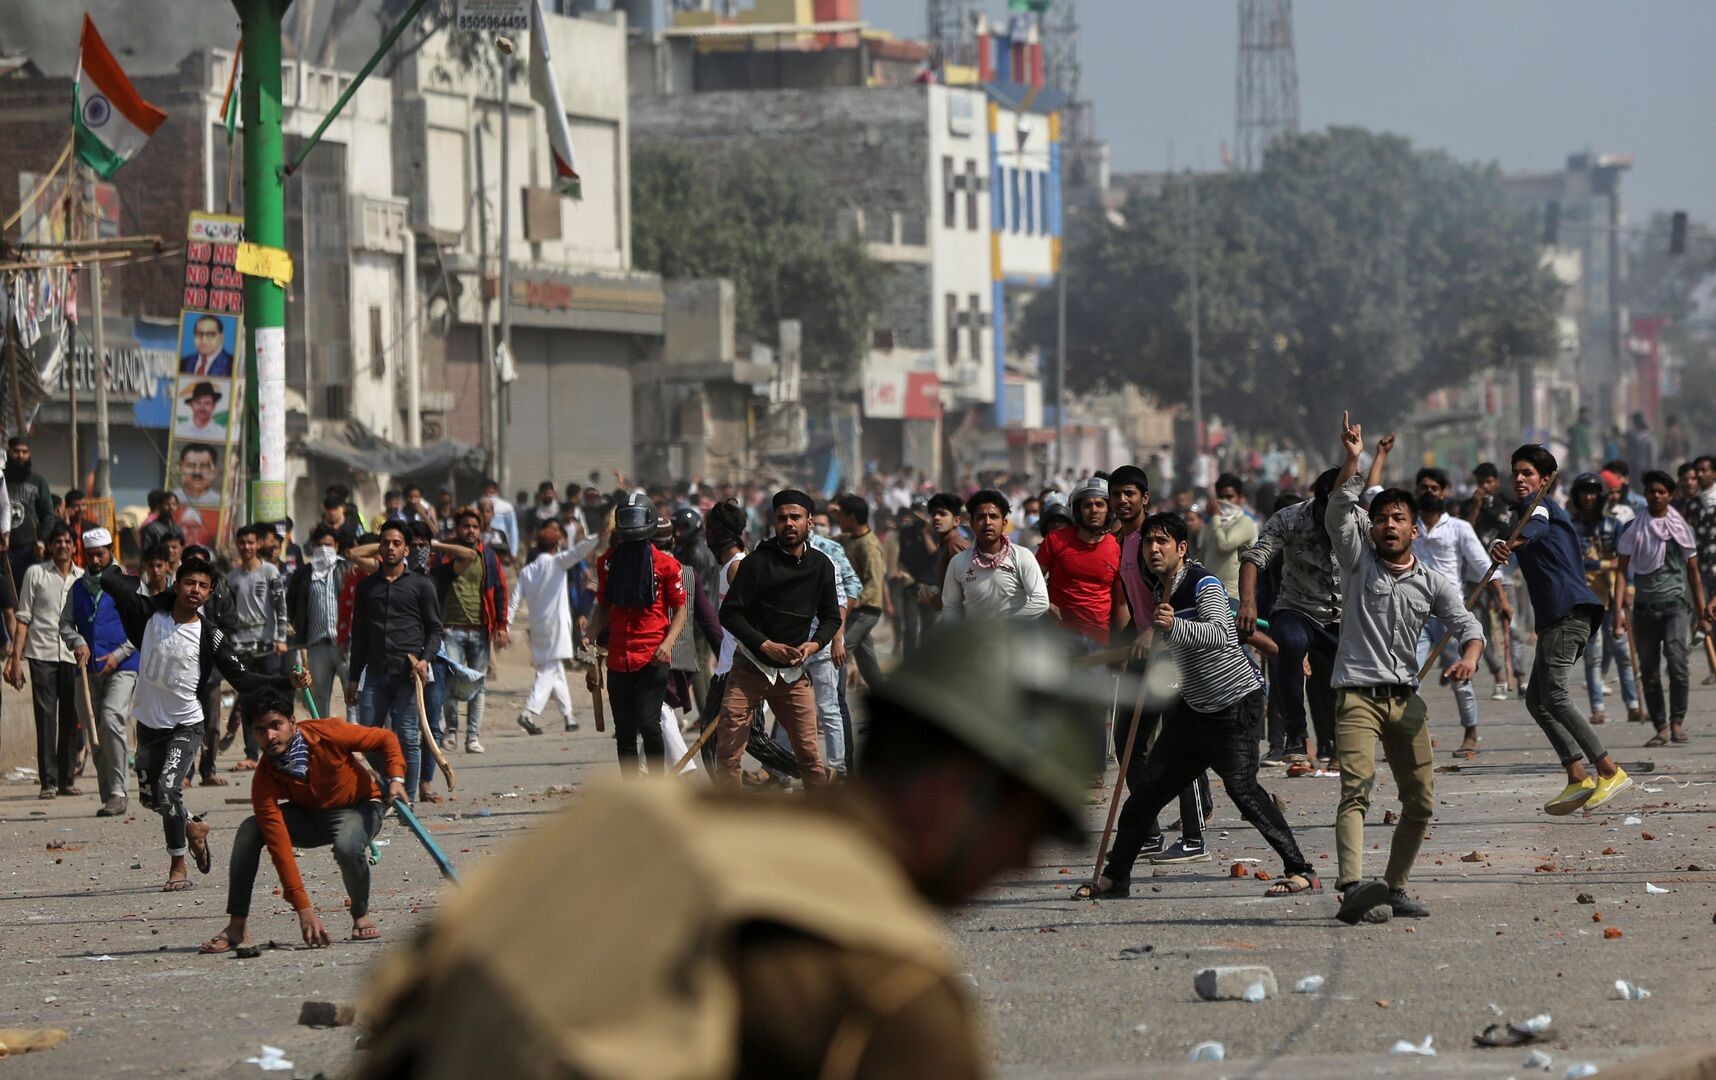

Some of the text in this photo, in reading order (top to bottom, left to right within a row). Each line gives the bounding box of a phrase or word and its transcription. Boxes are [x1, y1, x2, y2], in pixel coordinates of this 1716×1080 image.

[187, 241, 238, 266] NO NR
[185, 264, 243, 290] NO CAA
[184, 287, 241, 313] NO NPR
